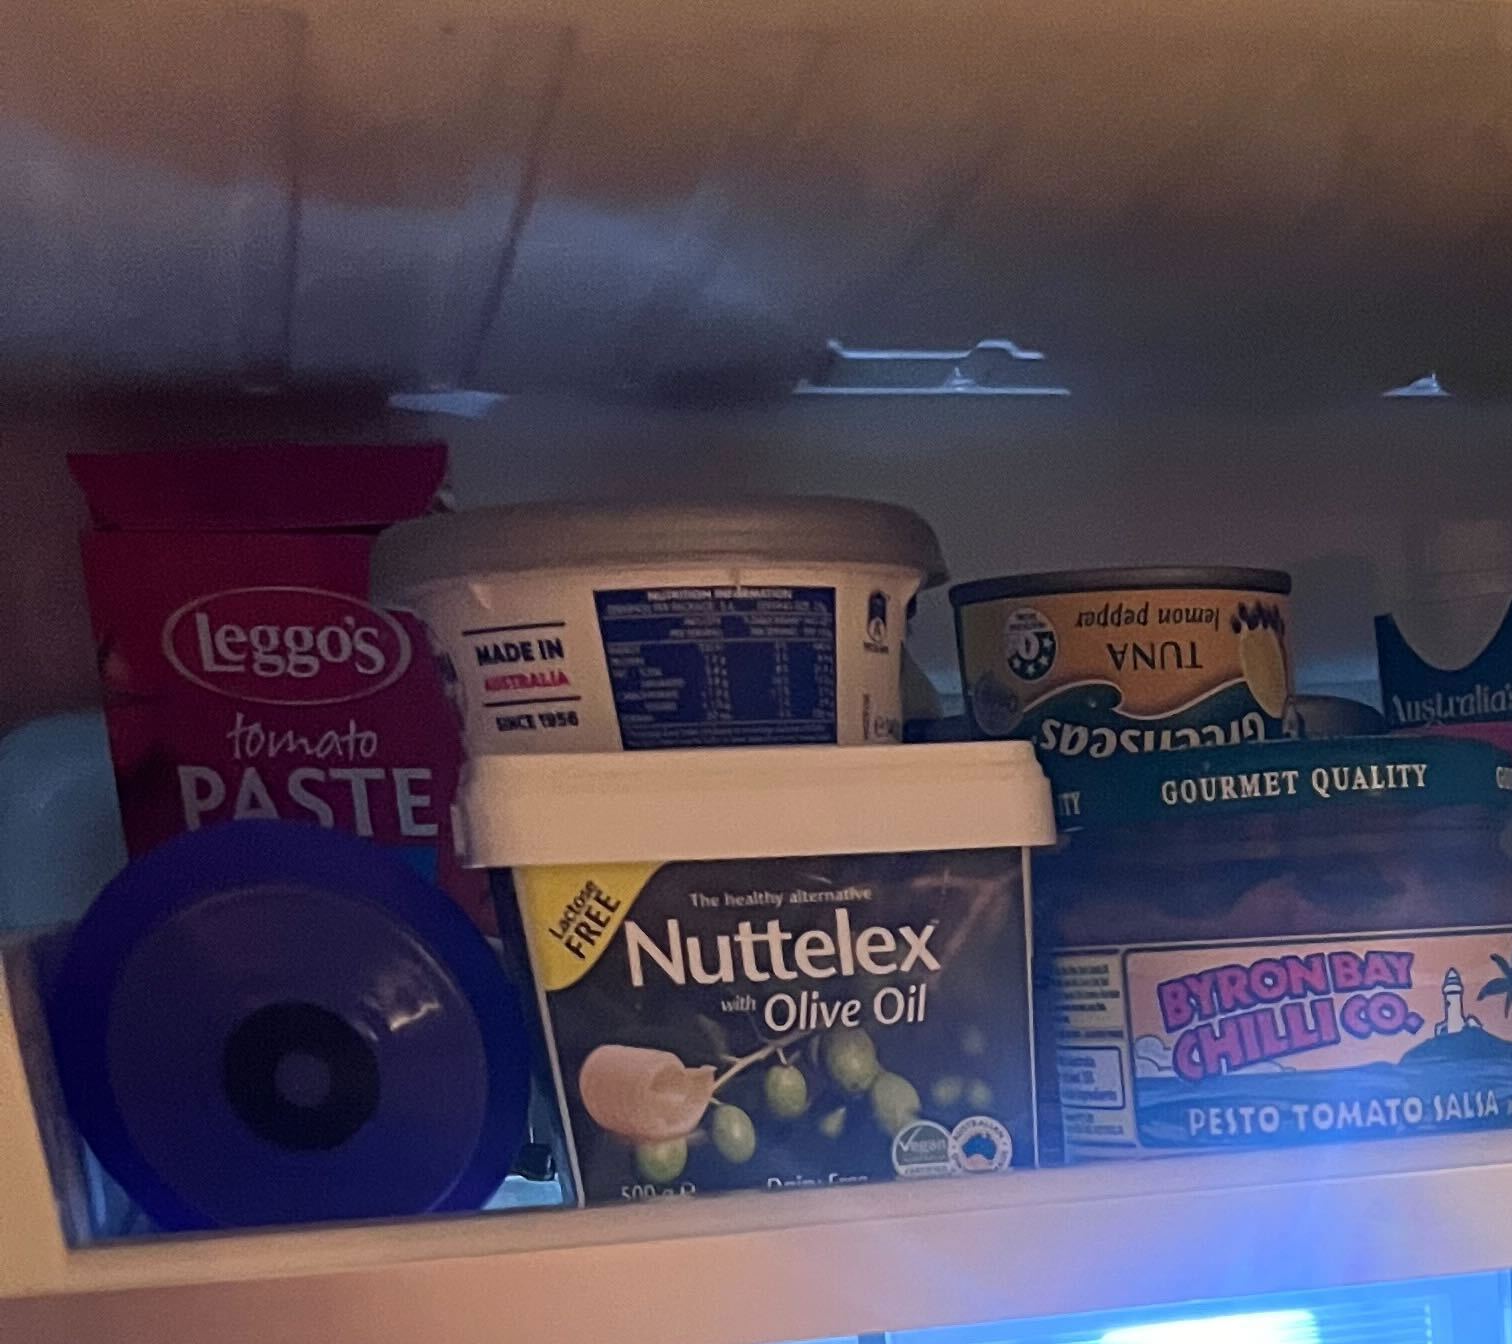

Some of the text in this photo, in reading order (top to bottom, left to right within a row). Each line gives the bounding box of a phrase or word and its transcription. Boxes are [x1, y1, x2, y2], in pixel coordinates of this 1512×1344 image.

[1073, 601, 1150, 628] pepper
[1157, 605, 1220, 632] lemon
[194, 611, 386, 678] Leggo's
[475, 637, 565, 667] MADE IN
[1104, 640, 1204, 671] TUNA
[484, 669, 570, 692] AUSTRALIA
[226, 711, 378, 760] tomato
[496, 710, 579, 732] SINCE 1956
[176, 764, 440, 838] PASTE
[1161, 763, 1428, 805] GOURMET QUALITY
[548, 879, 597, 940] Lactose
[689, 886, 874, 909] The healthy alternative
[564, 890, 621, 959] FREE
[624, 907, 942, 988] Nuttelex
[720, 983, 928, 1033] with Olive Oil
[1157, 951, 1329, 1033] BYRON
[1329, 949, 1416, 994] BAY
[1172, 996, 1342, 1082] CHILLI
[1340, 991, 1425, 1040] CO.
[1189, 1104, 1280, 1136] PESTO
[1293, 1095, 1424, 1133] TOMATO
[1433, 1090, 1499, 1122] SALSA
